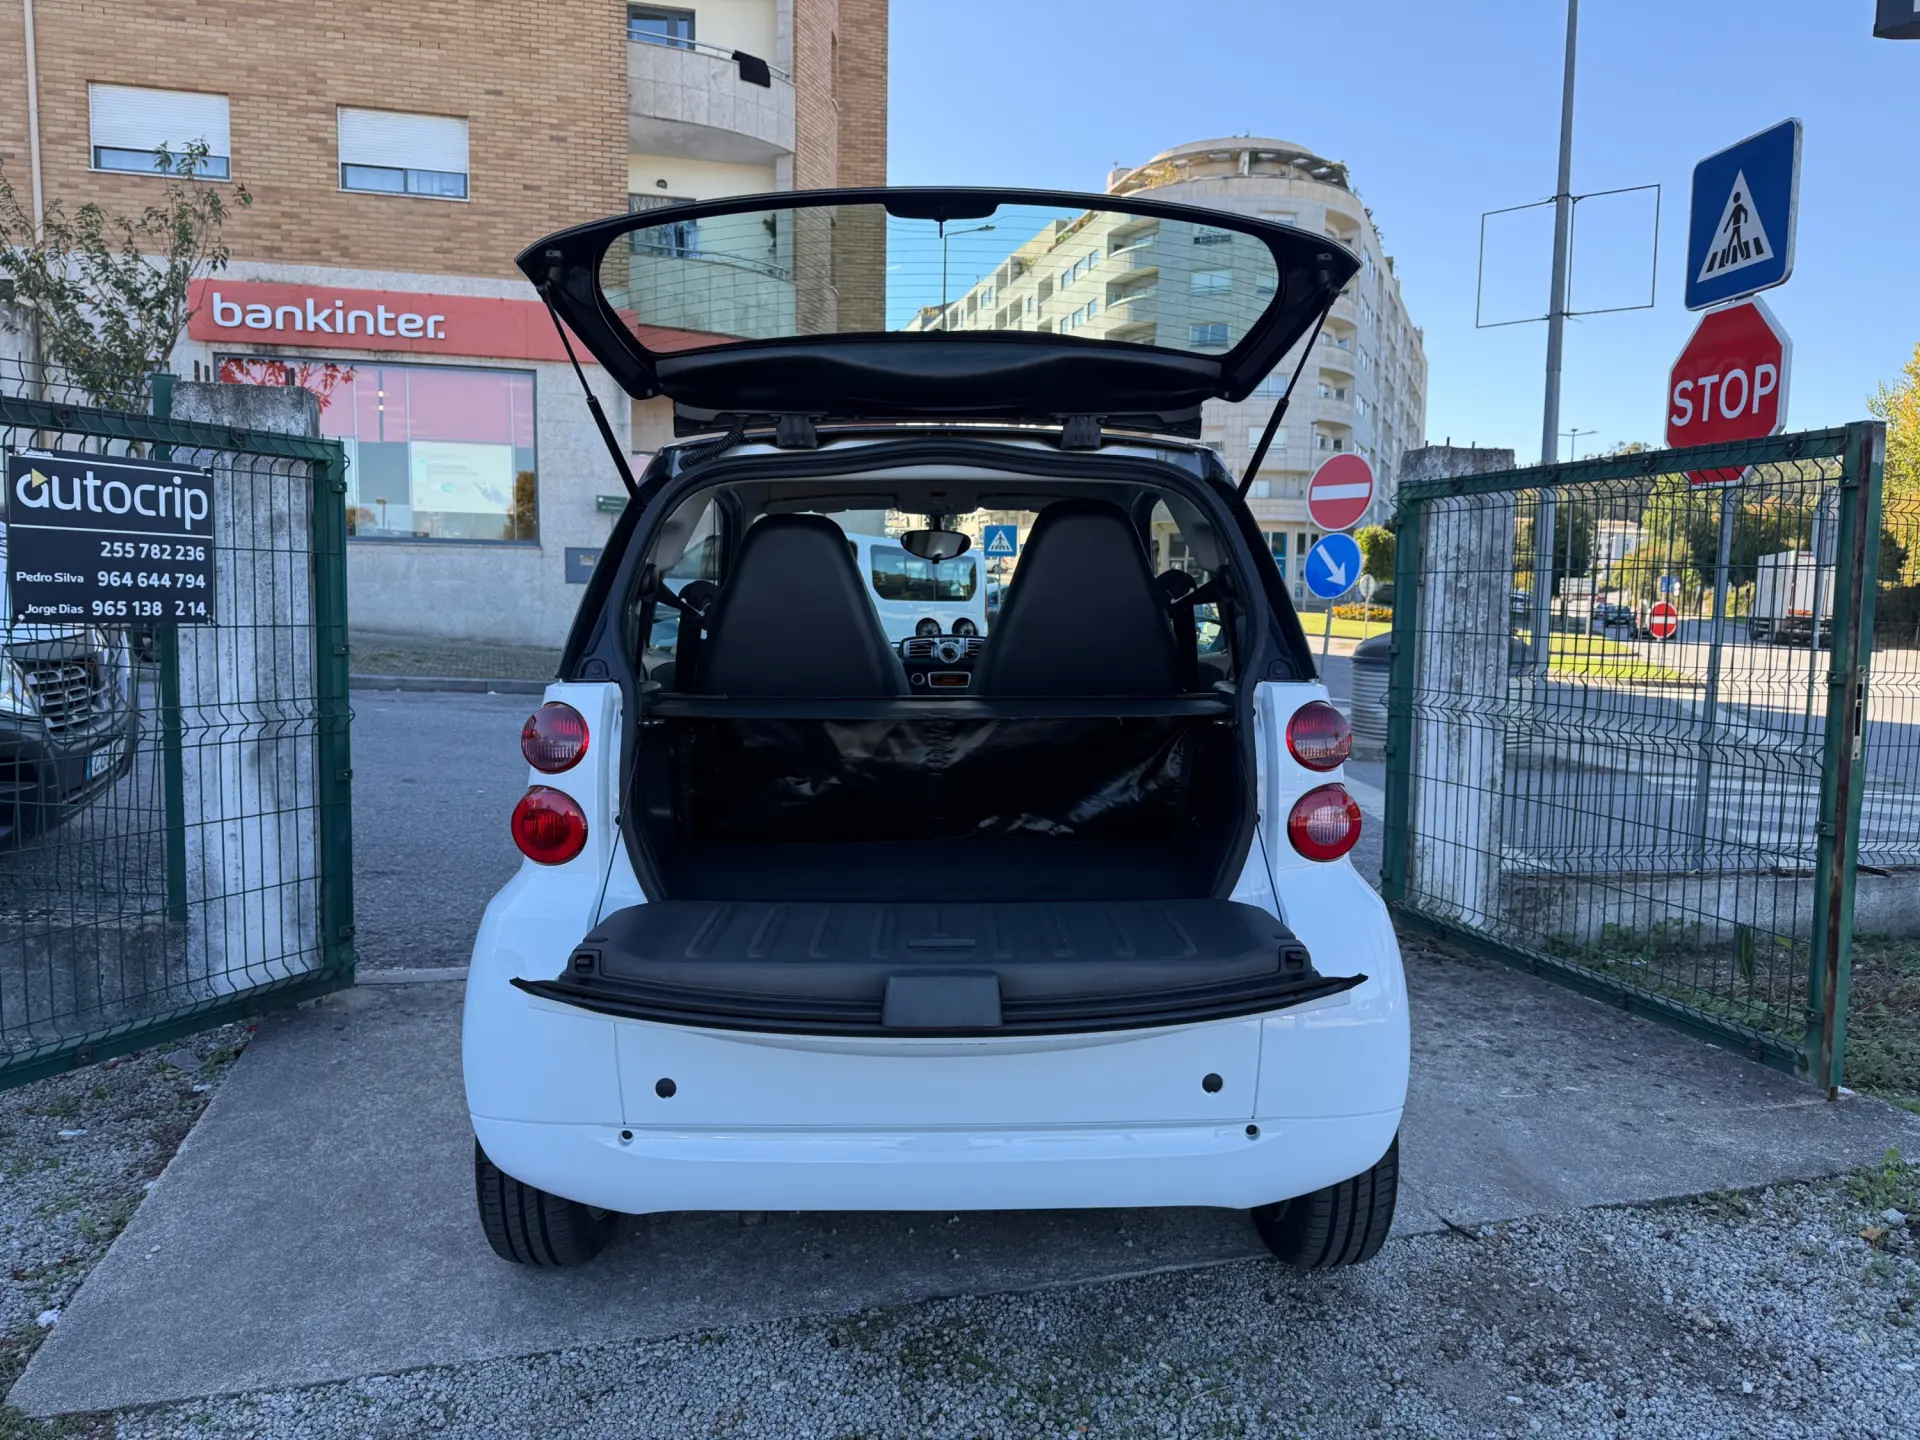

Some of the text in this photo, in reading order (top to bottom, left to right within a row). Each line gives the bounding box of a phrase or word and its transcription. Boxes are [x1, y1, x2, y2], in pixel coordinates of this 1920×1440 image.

[212, 292, 446, 340] bankinter.
[1671, 363, 1777, 427] STOP
[16, 469, 208, 530] autocrip
[100, 541, 205, 561] 255 782 236
[16, 571, 206, 589] Pedro Silva 964 644 794
[25, 600, 206, 616] Jorge Dias 965 138 214
